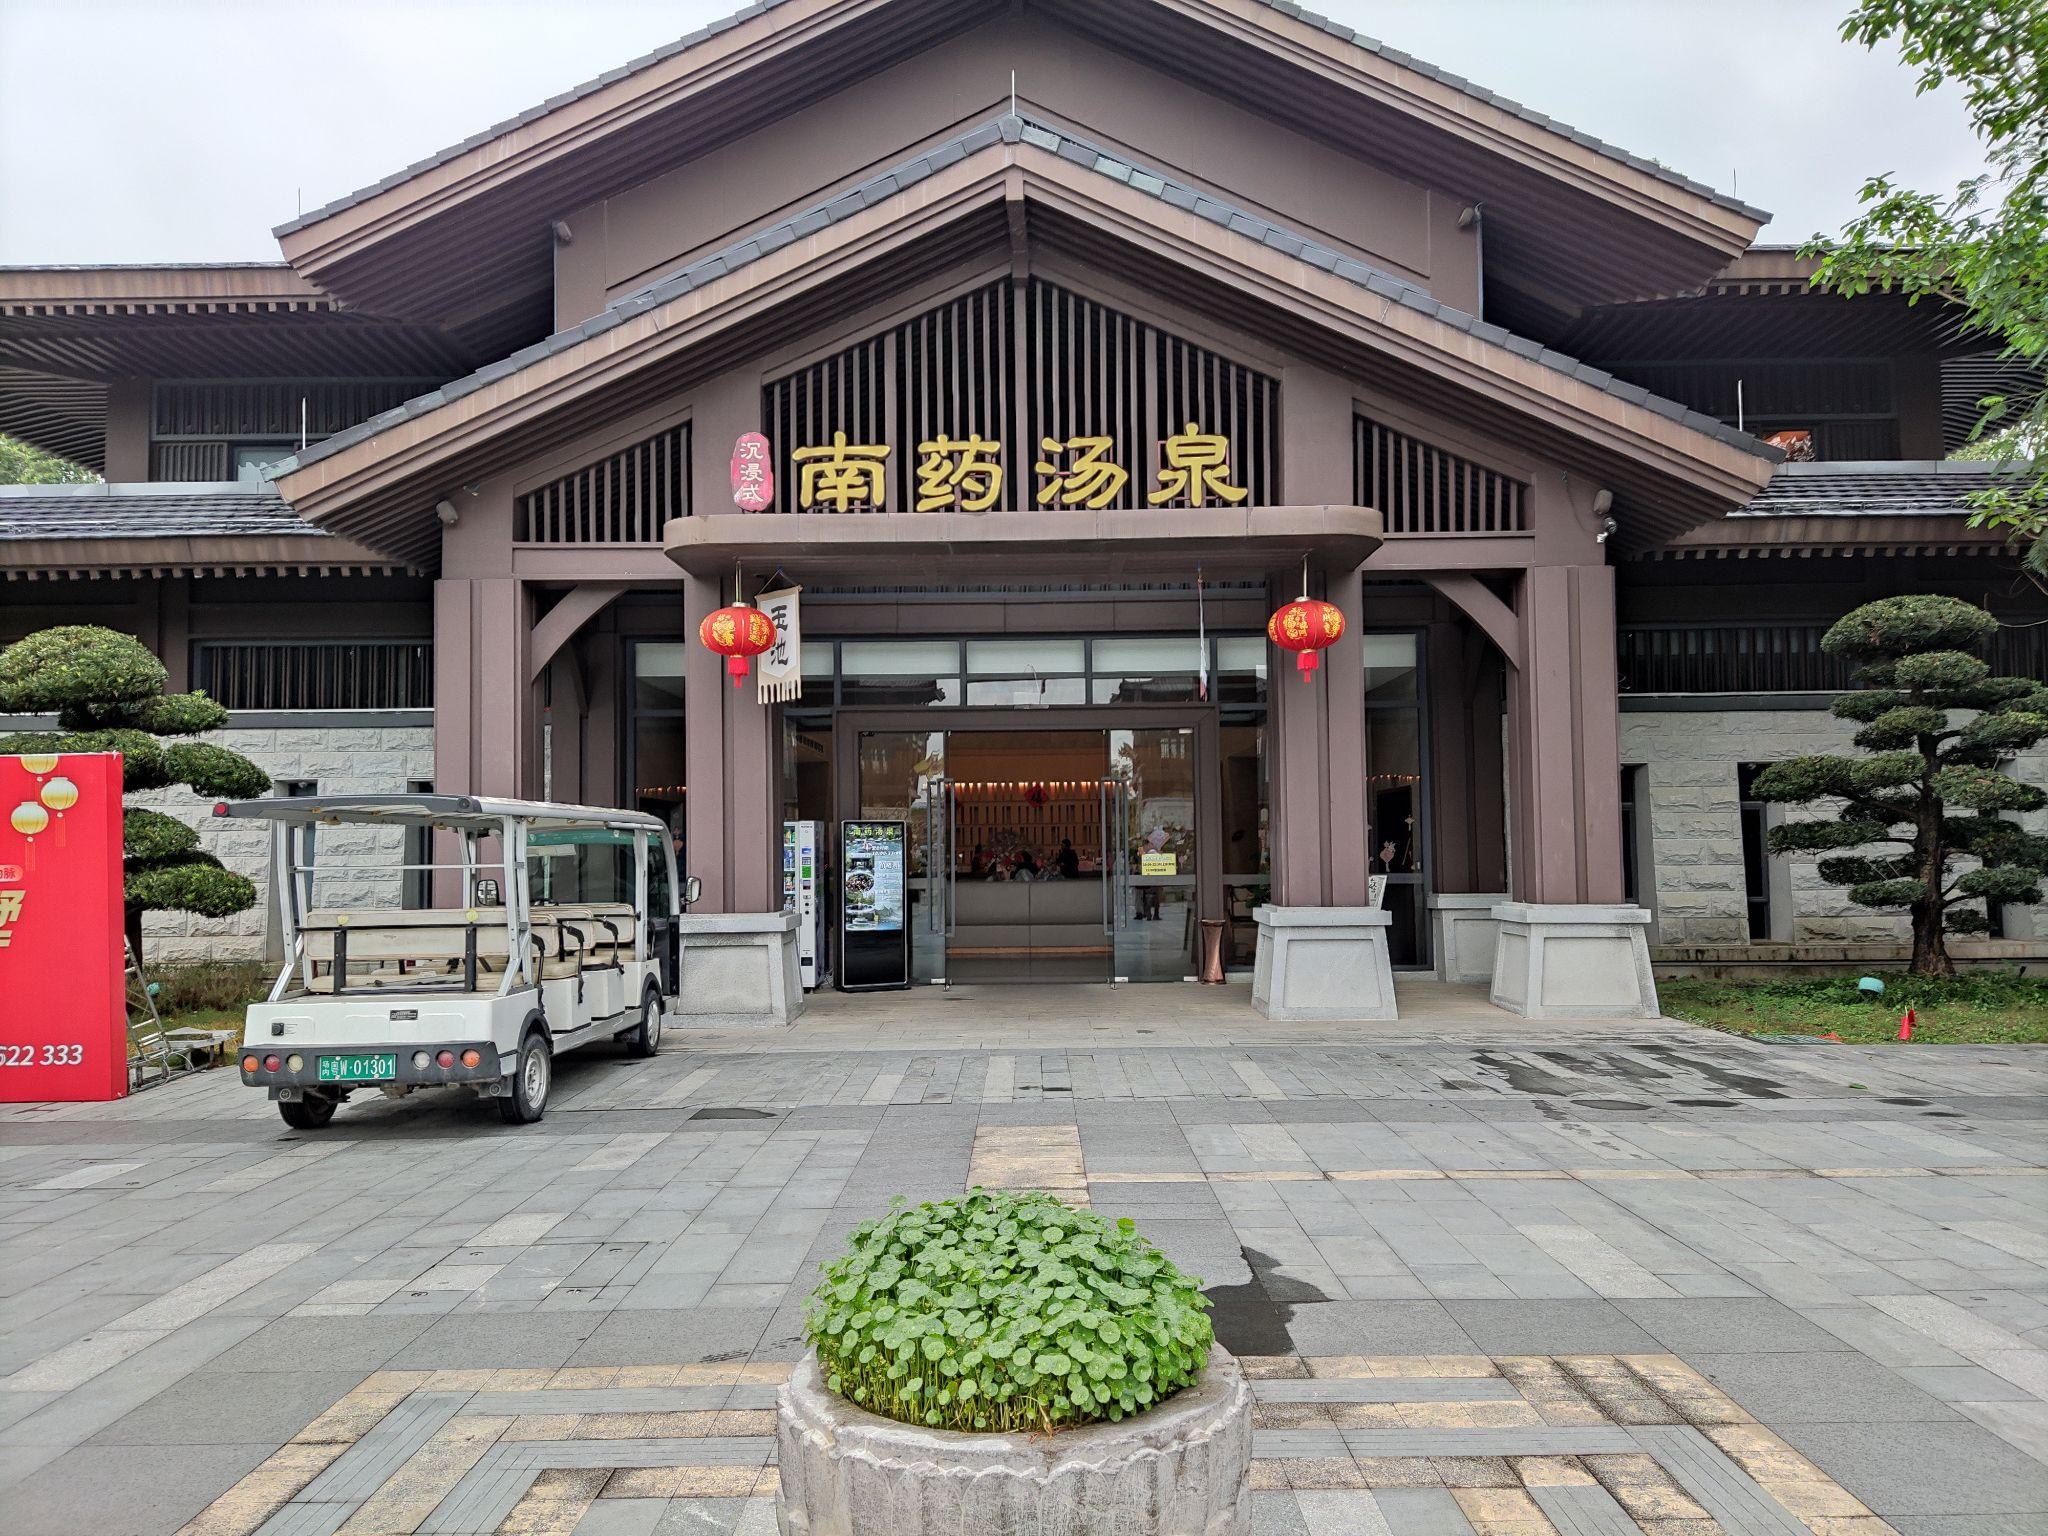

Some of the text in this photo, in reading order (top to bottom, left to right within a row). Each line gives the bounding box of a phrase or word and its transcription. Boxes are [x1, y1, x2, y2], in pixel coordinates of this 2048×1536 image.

[740, 442, 764, 501] 沉浸式
[792, 423, 1249, 512] 南药汤泉
[39, 1044, 83, 1066] 333
